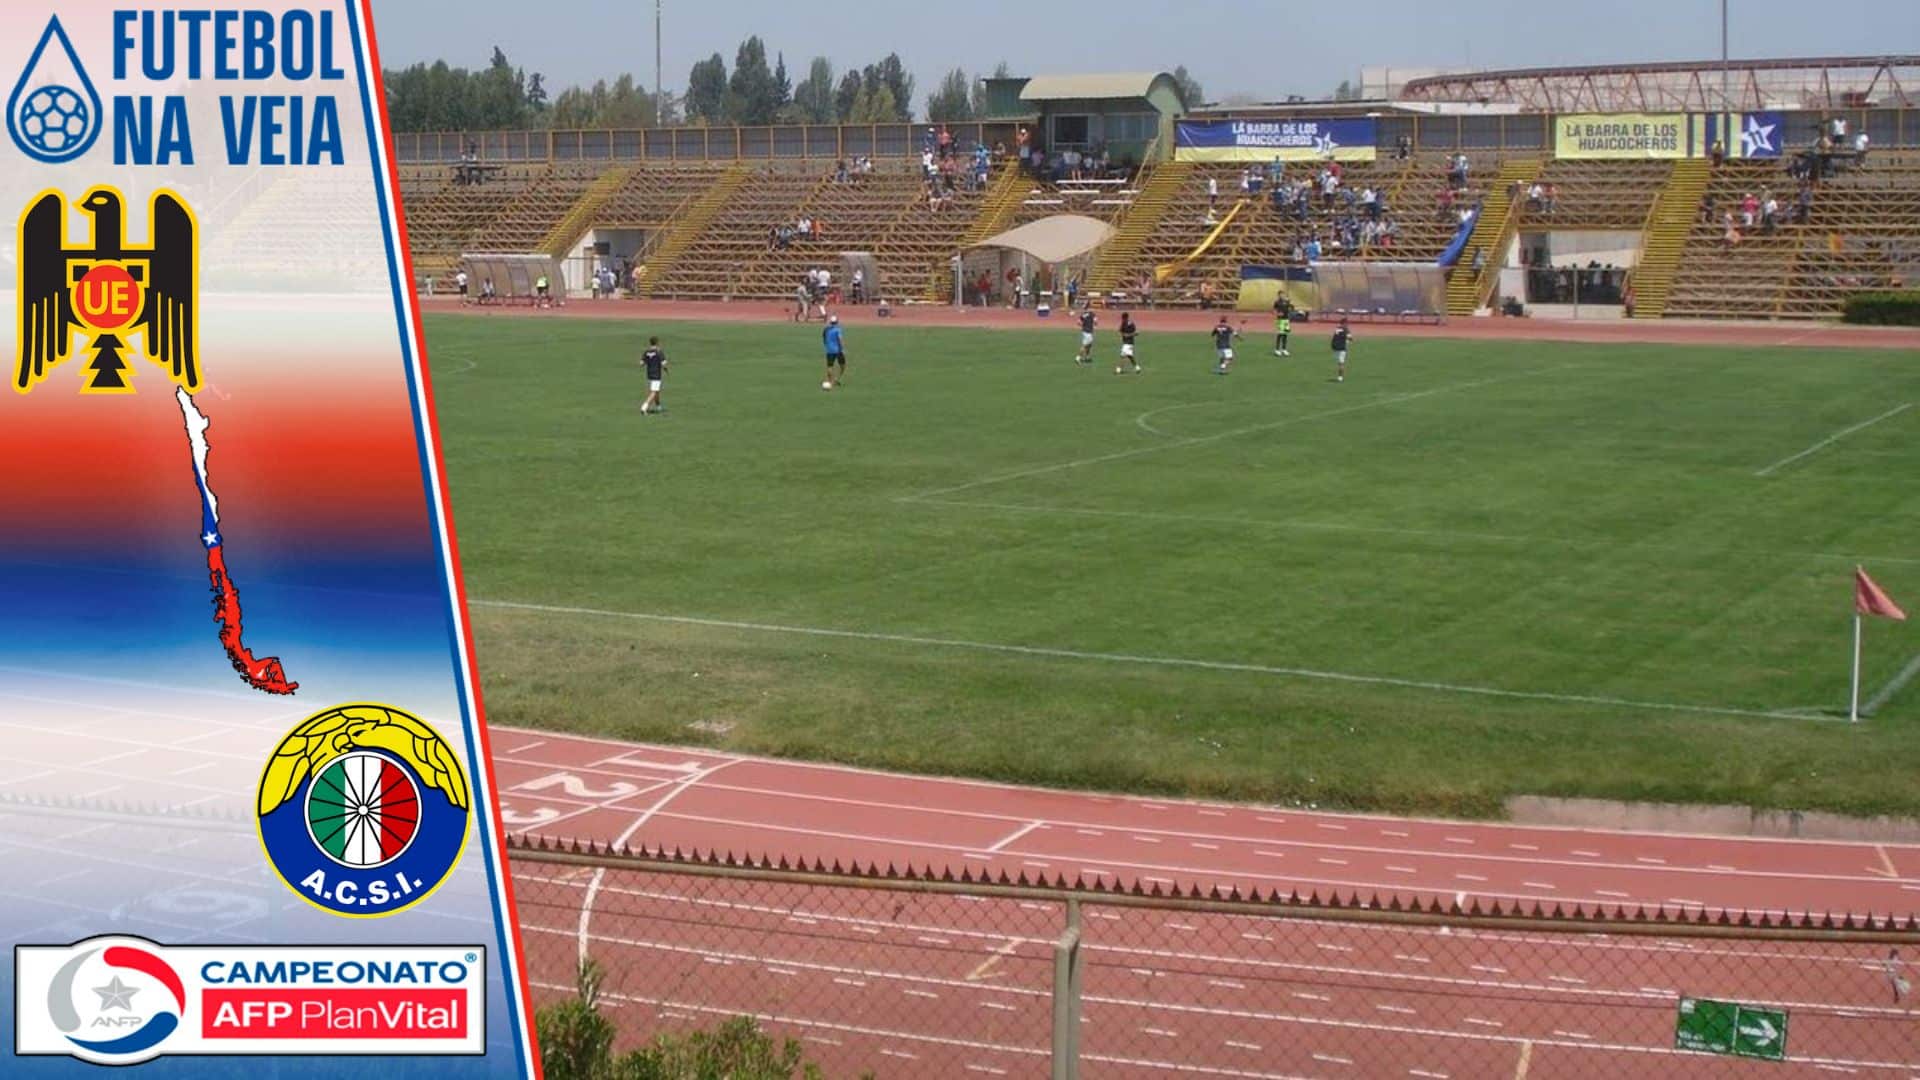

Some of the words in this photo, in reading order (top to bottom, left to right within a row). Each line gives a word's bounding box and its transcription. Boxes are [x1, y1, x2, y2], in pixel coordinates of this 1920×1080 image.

[1247, 123, 1280, 134] BARRA
[1282, 123, 1297, 134] DE
[1298, 123, 1318, 135] LOS
[1566, 124, 1581, 137] LA
[1585, 124, 1629, 136] BARRA
[1633, 124, 1650, 136] DE
[1654, 124, 1678, 136] LOS
[1578, 138, 1677, 150] HUAICOCHEROS
